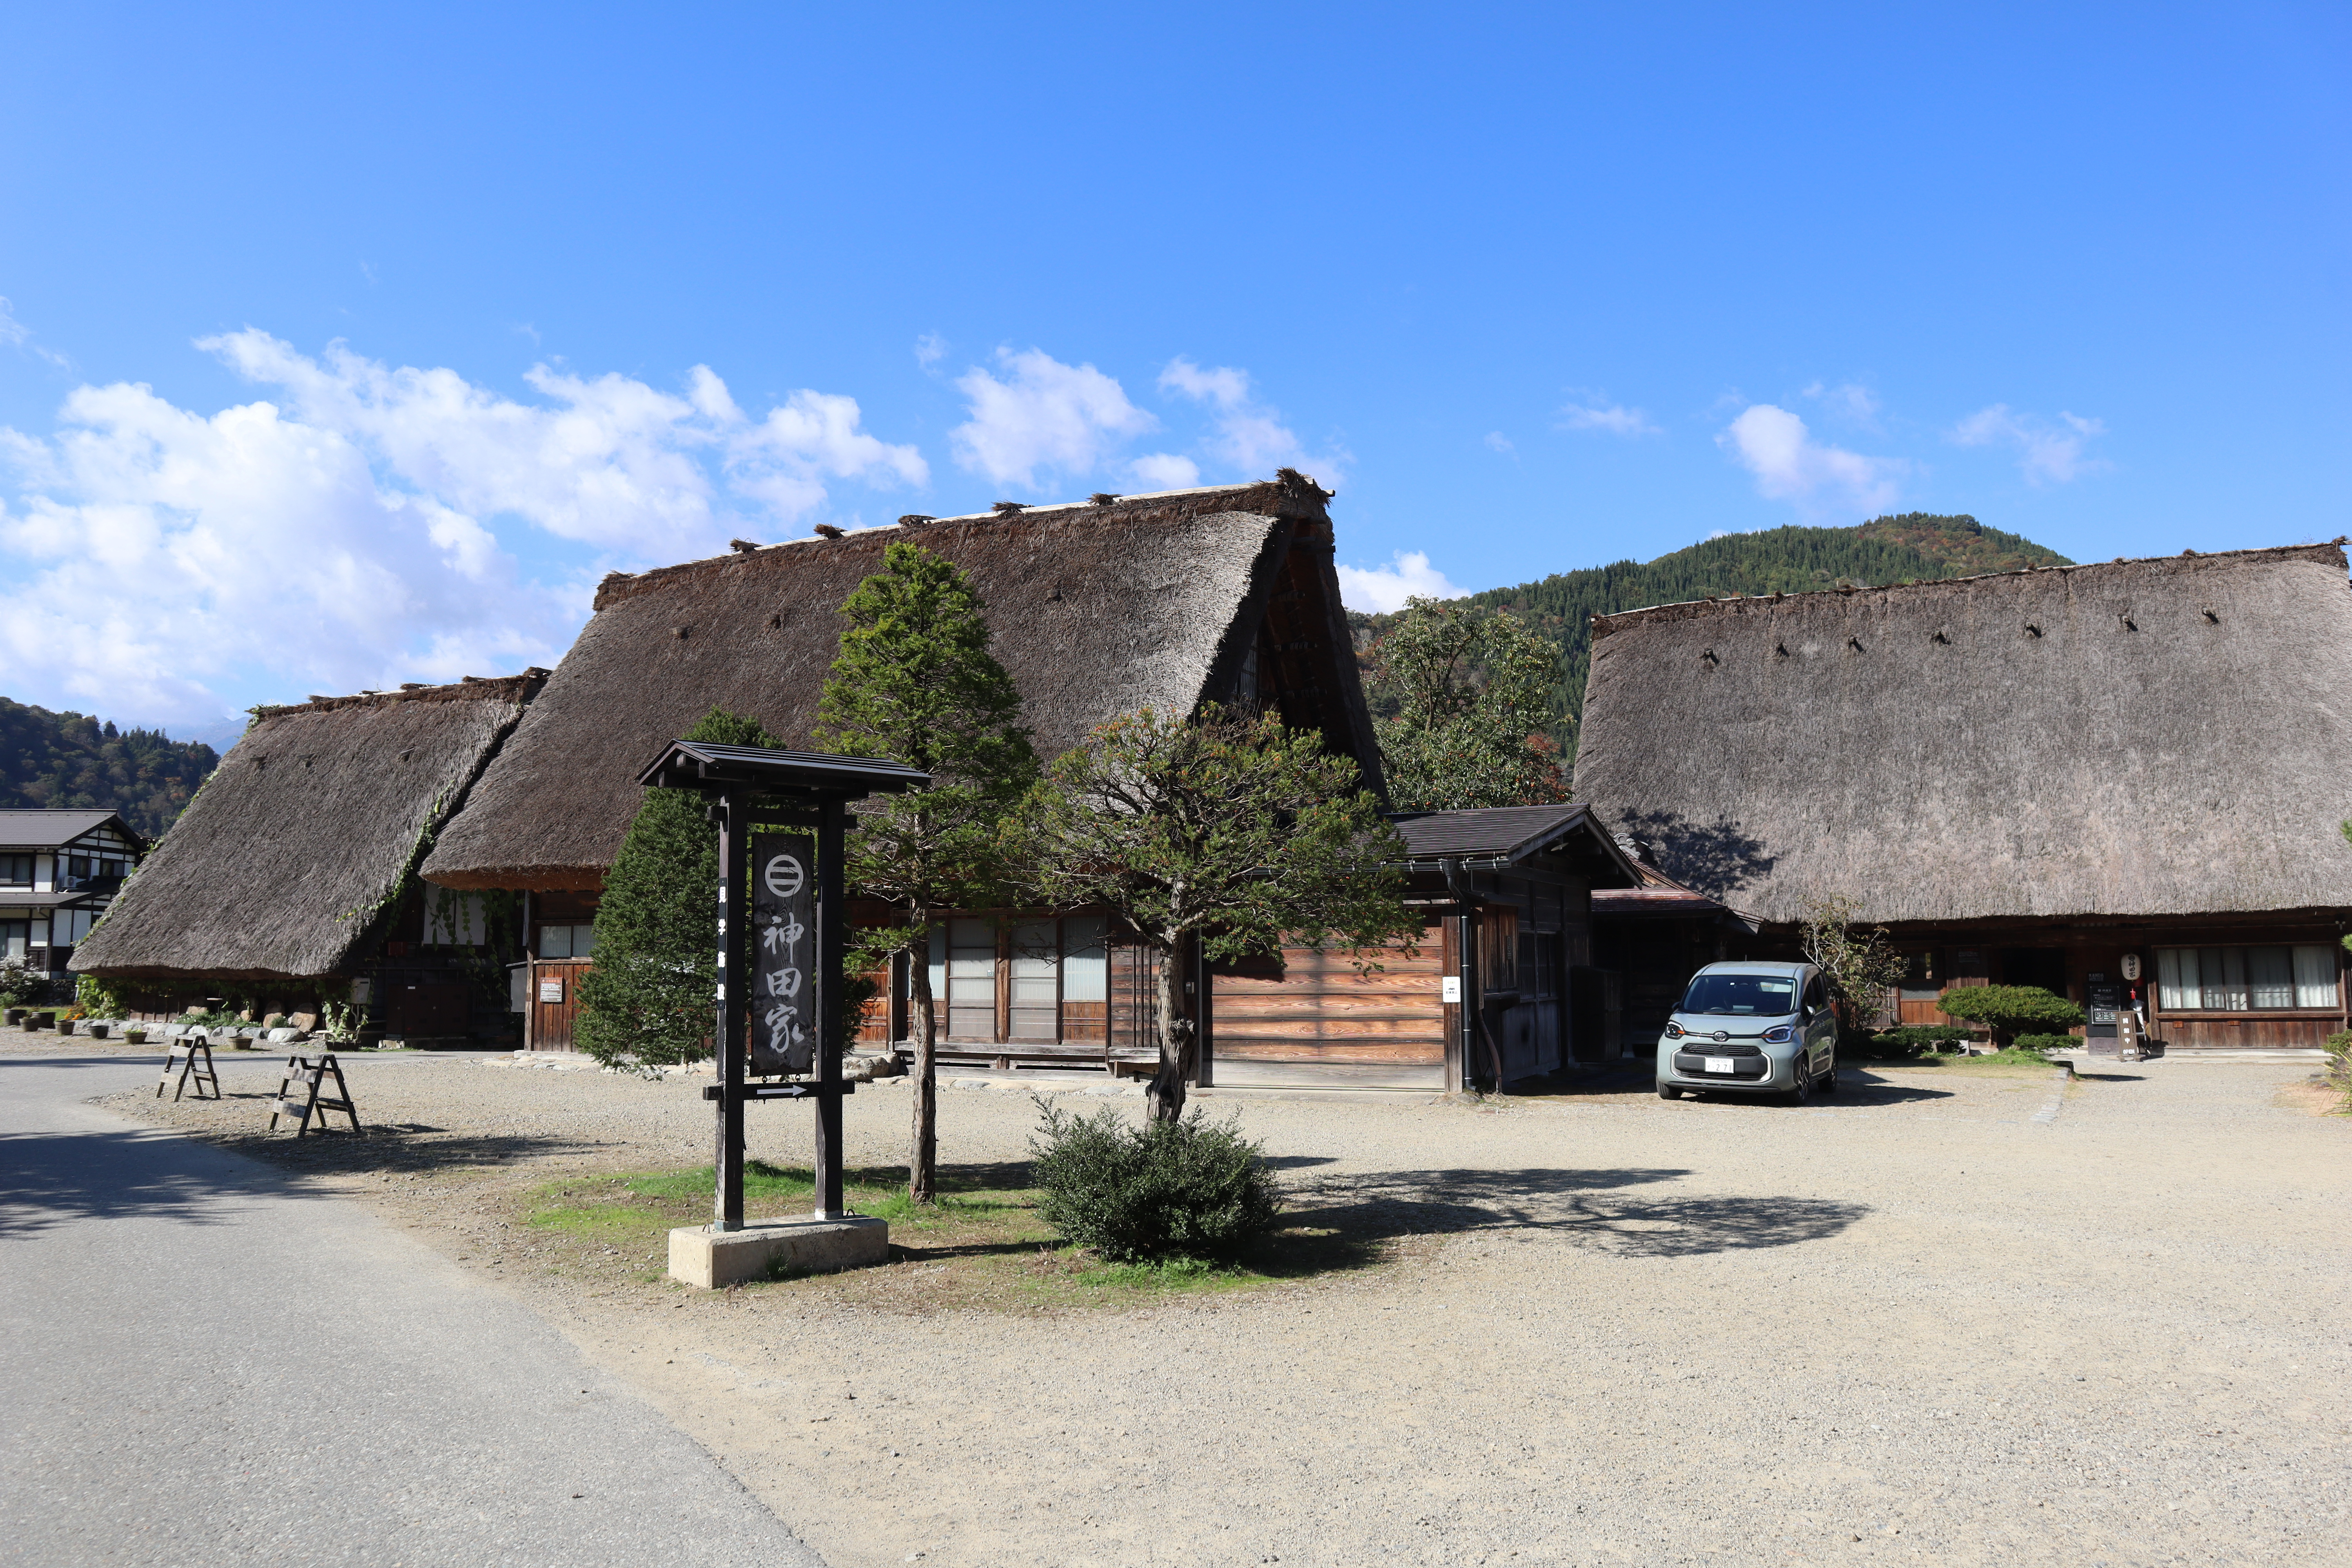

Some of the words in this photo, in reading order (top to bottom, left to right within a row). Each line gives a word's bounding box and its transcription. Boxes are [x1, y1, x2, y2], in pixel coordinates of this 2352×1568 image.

[717, 886, 726, 1000] 見学施設
[763, 912, 804, 1054] 神田家
